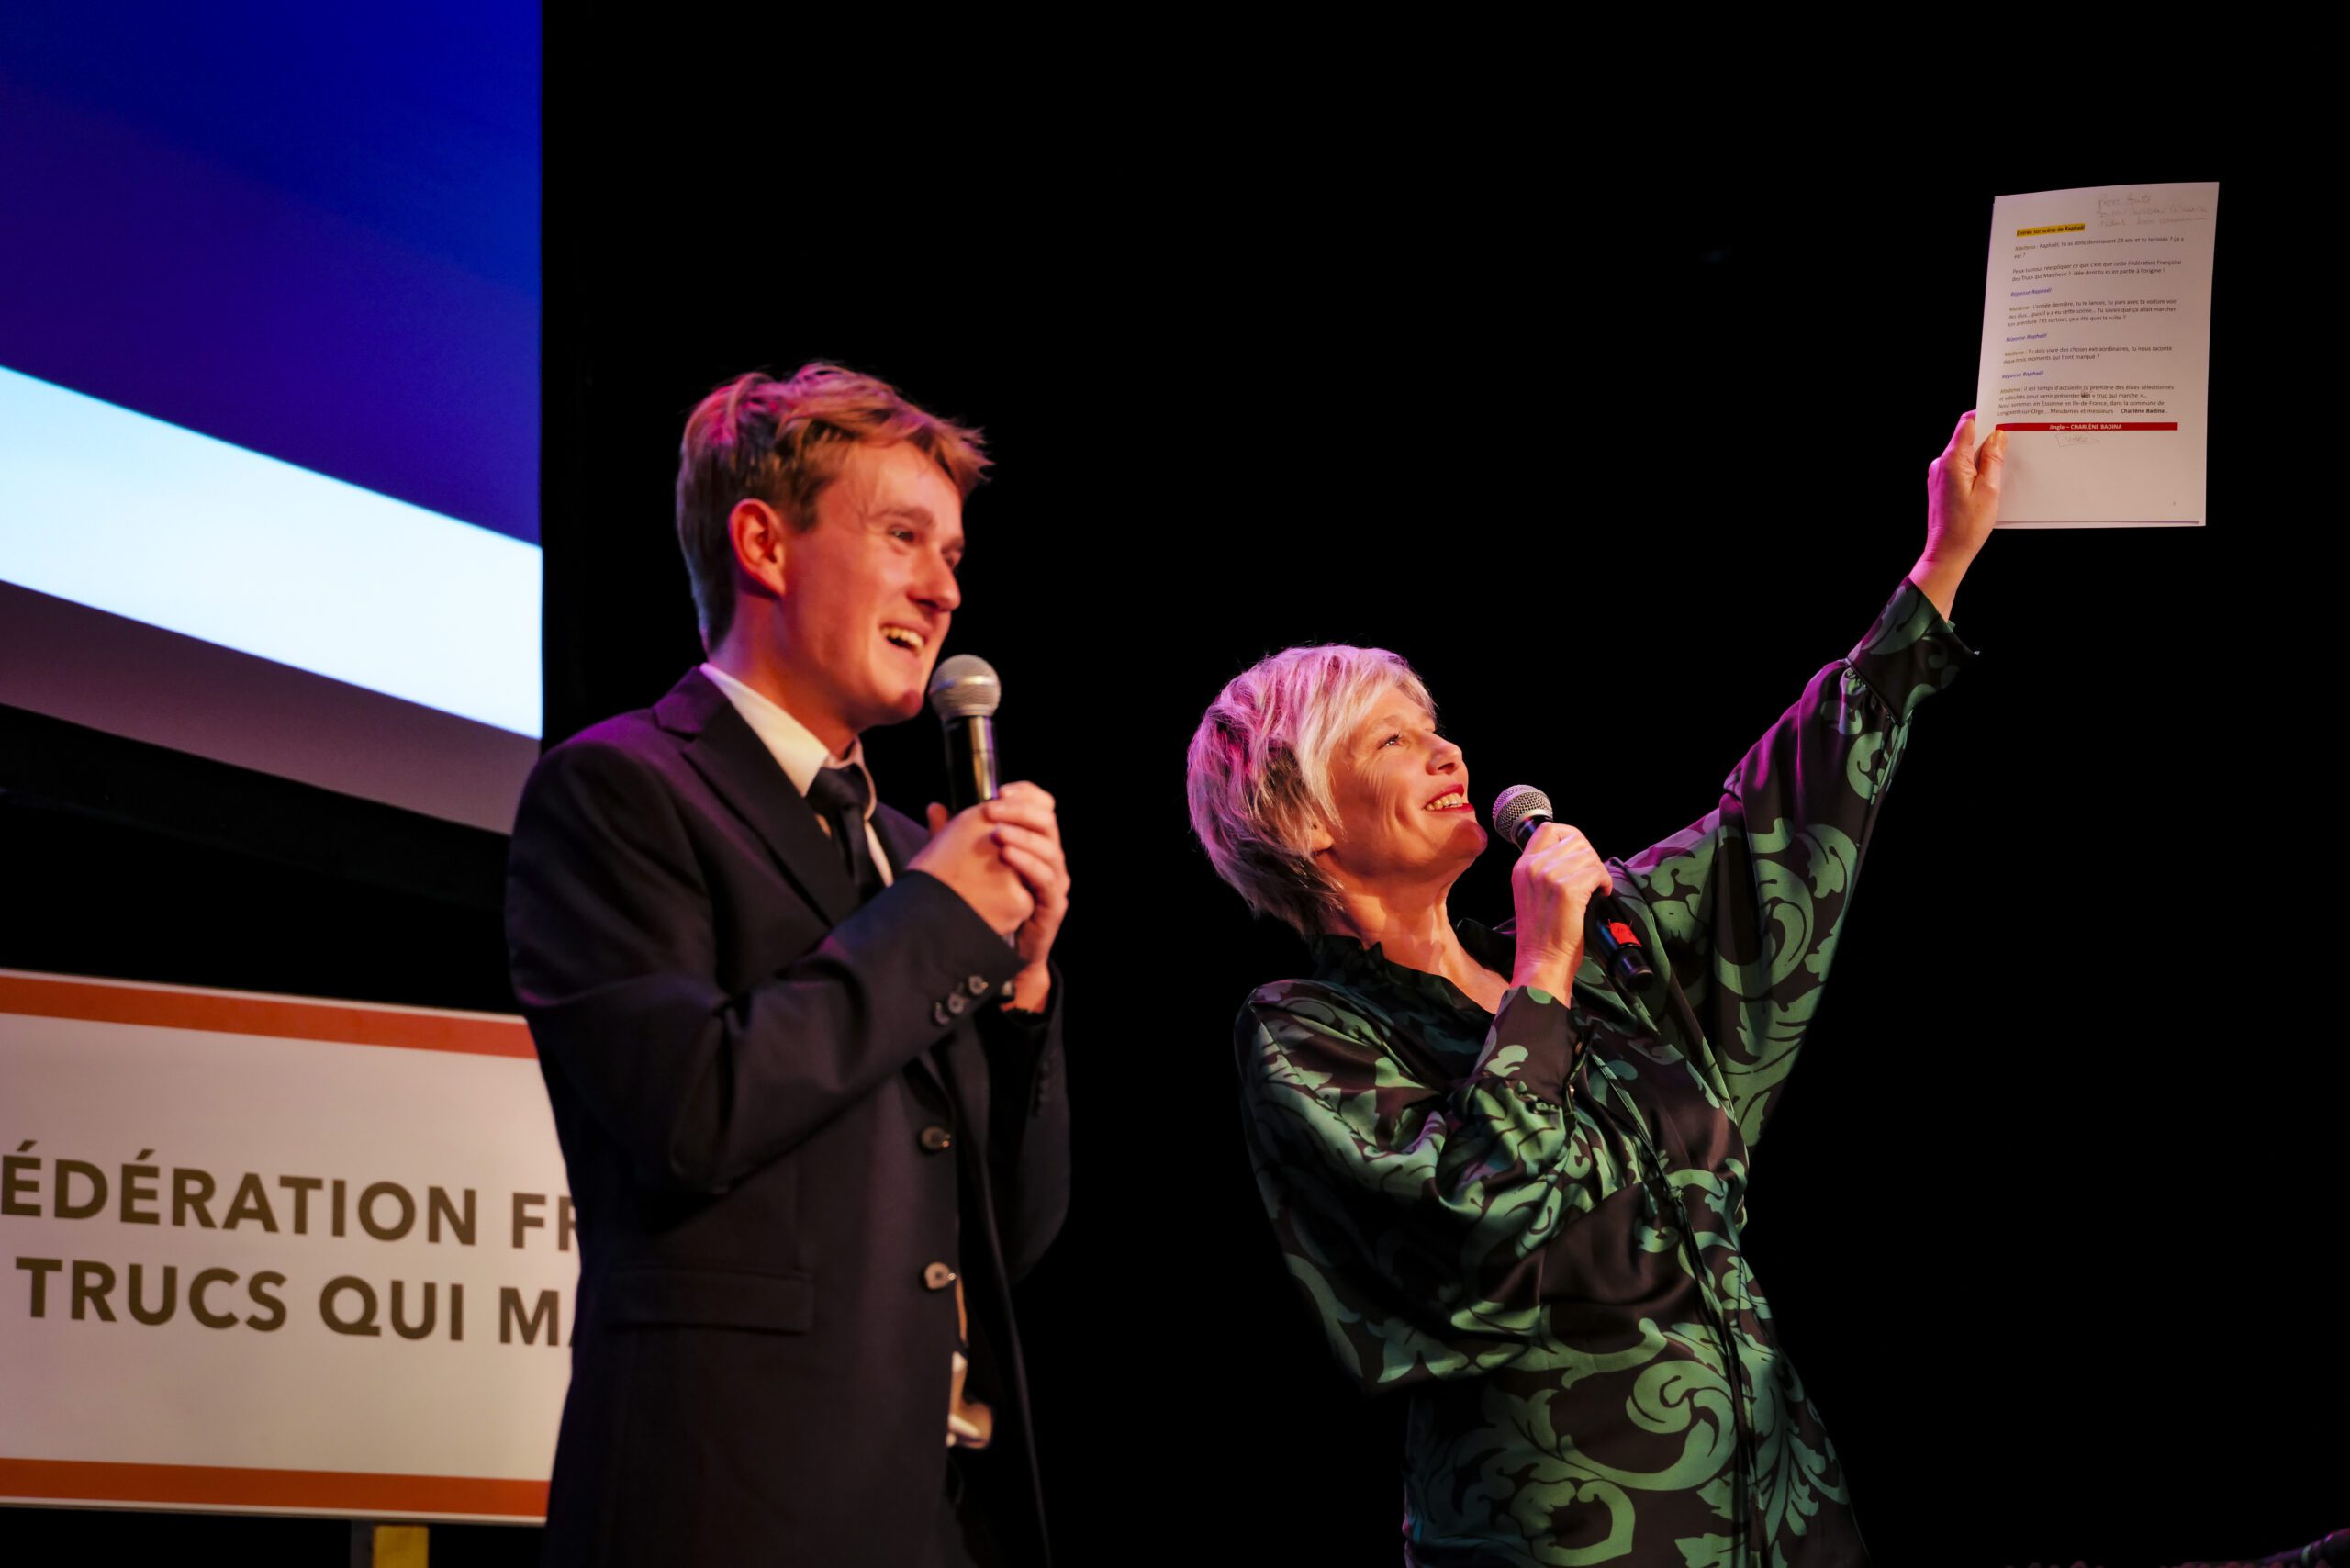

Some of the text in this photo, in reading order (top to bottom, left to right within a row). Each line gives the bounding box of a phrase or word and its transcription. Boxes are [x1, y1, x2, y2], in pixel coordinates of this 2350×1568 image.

[16, 1257, 572, 1347] TRUCS QUI M
